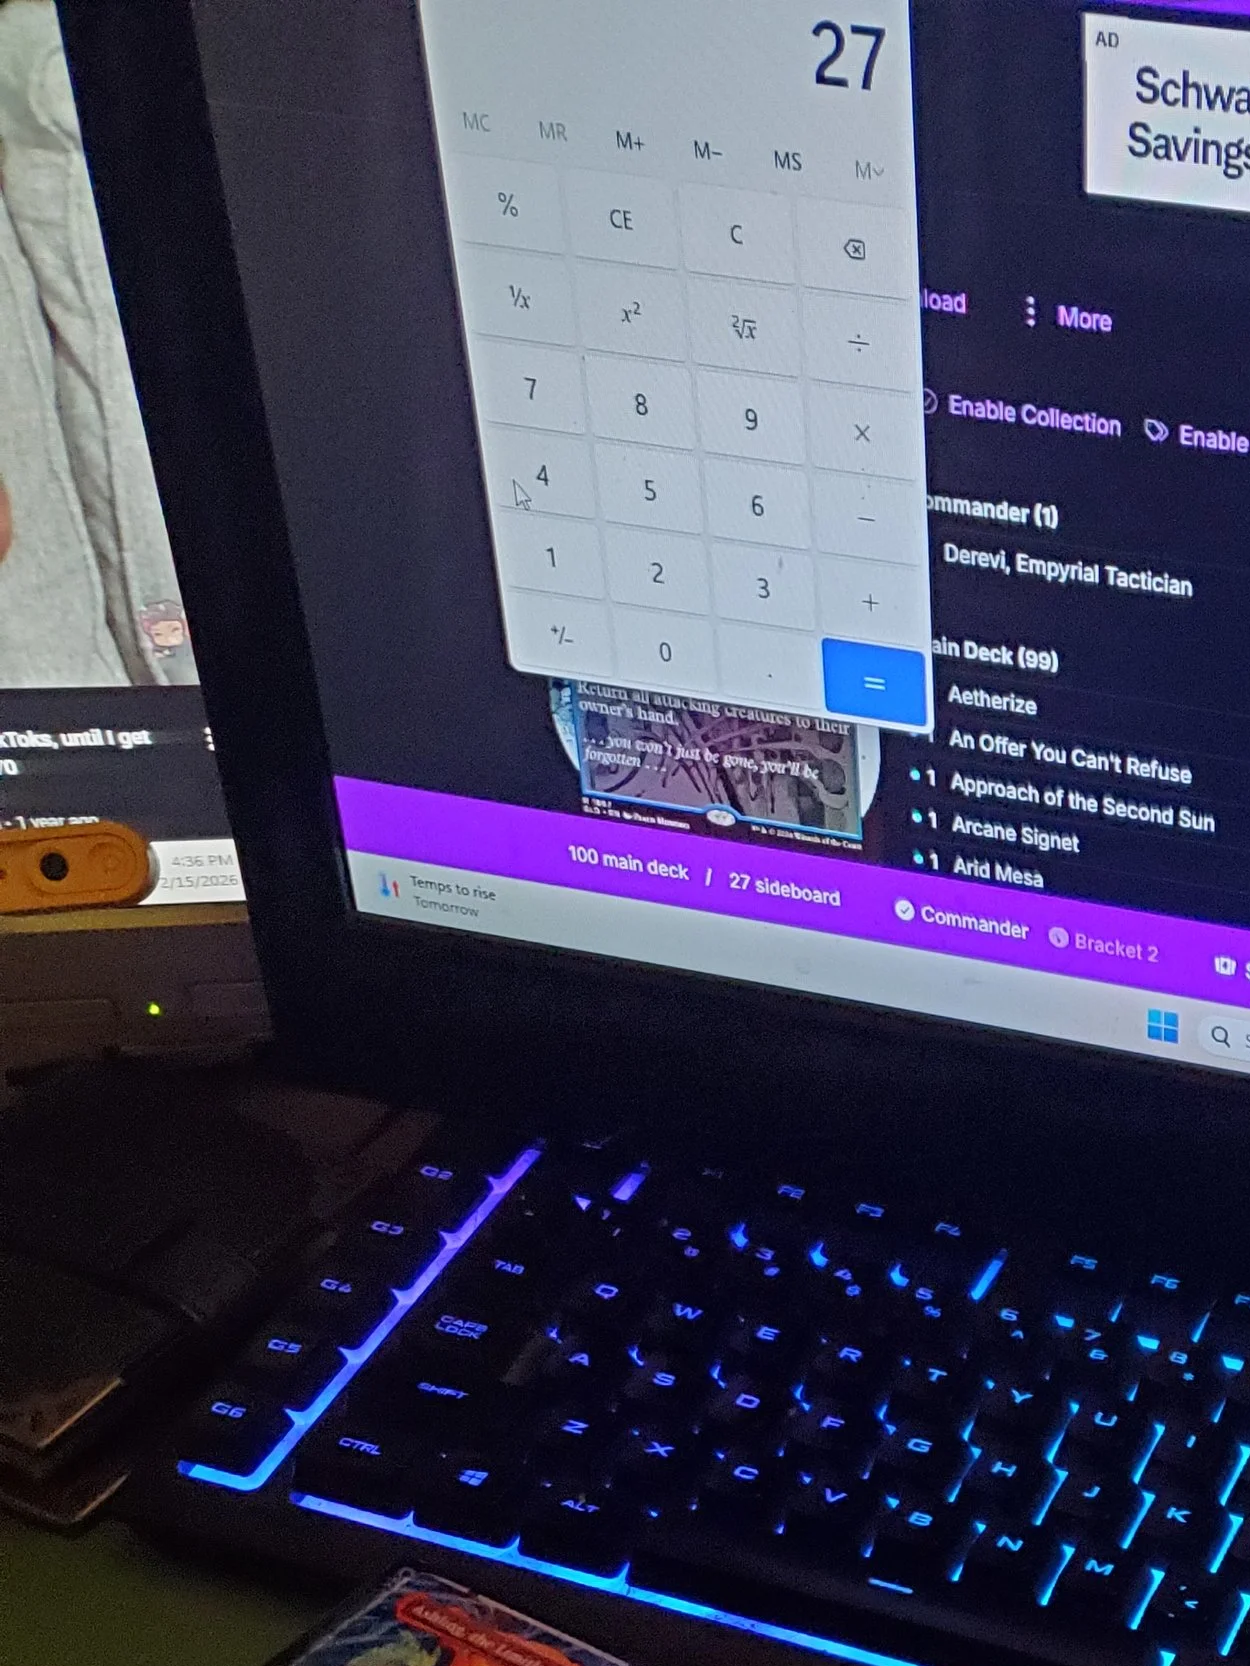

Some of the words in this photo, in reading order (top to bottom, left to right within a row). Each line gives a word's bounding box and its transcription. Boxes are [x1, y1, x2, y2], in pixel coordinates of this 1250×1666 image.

[811, 19, 887, 91] 27
[1095, 31, 1120, 49] AD
[462, 111, 491, 133] MC
[538, 120, 568, 142] MR
[615, 130, 645, 152] M+
[773, 149, 803, 172] MS
[609, 209, 634, 231] CE
[730, 225, 744, 245] C
[921, 288, 967, 315] load
[1057, 304, 1113, 333] More
[948, 394, 1017, 424] Enable
[1021, 403, 1122, 438] Collection
[1179, 424, 1249, 454] Enable
[926, 494, 1030, 525] ommander
[1033, 503, 1059, 531] (1)
[943, 542, 1012, 576] Derevi,
[1015, 554, 1100, 587] Empyrial
[1104, 565, 1193, 598] Tactician
[932, 638, 960, 659] ain
[963, 641, 1014, 667] Deck
[1017, 645, 1059, 674] (99)
[948, 684, 1038, 717] Aetherize
[60, 728, 105, 747] until
[118, 730, 153, 750] get
[949, 729, 975, 750] An
[979, 732, 1028, 760] Offer
[1031, 741, 1067, 765] You
[1070, 748, 1122, 773] Can't
[1126, 756, 1193, 785] Refuse
[950, 772, 1040, 806] Approach
[1043, 786, 1065, 807] of
[1068, 790, 1098, 813] the
[1102, 797, 1174, 827] Second
[1178, 809, 1216, 834] Sun
[952, 815, 1017, 843] Arcane
[1021, 826, 1080, 854] Signet
[171, 855, 204, 868] 4:36
[207, 854, 234, 867] PM
[568, 844, 600, 865] 100
[603, 852, 644, 874] main
[647, 858, 689, 881] deck
[728, 872, 751, 891] 27
[755, 876, 841, 908] sideboard
[410, 874, 453, 897] Temps
[455, 881, 471, 897] to
[473, 883, 497, 902] rise
[414, 894, 480, 919] Tomorrow
[920, 904, 1030, 942] Commander
[1074, 932, 1144, 963] Bracket
[1147, 944, 1160, 964] 2
[338, 1437, 382, 1456] CTRL
